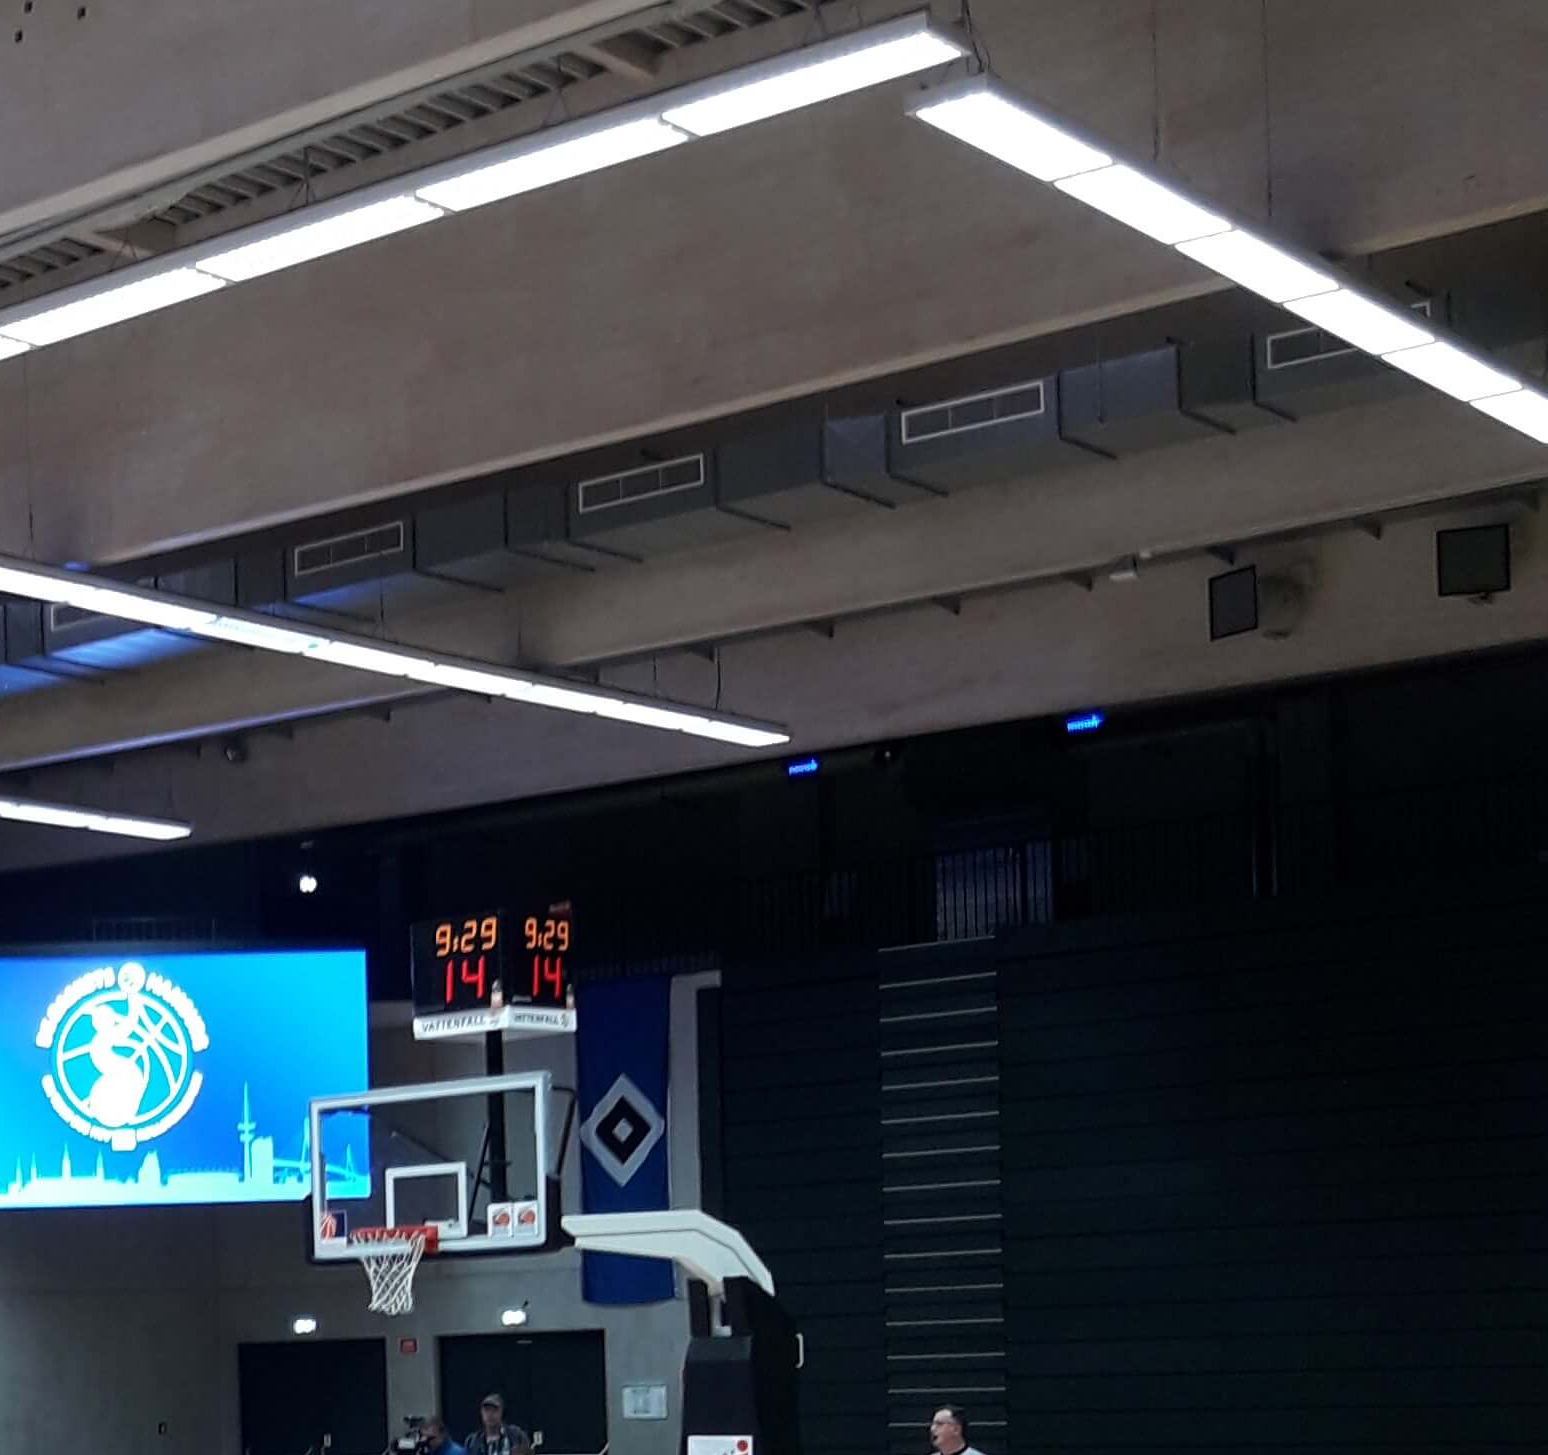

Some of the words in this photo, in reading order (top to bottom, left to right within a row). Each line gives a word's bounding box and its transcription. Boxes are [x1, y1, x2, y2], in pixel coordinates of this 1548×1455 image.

[435, 915, 498, 958] 9:29
[524, 916, 570, 951] 9:29
[445, 954, 486, 1005] 14
[532, 953, 563, 999] 14
